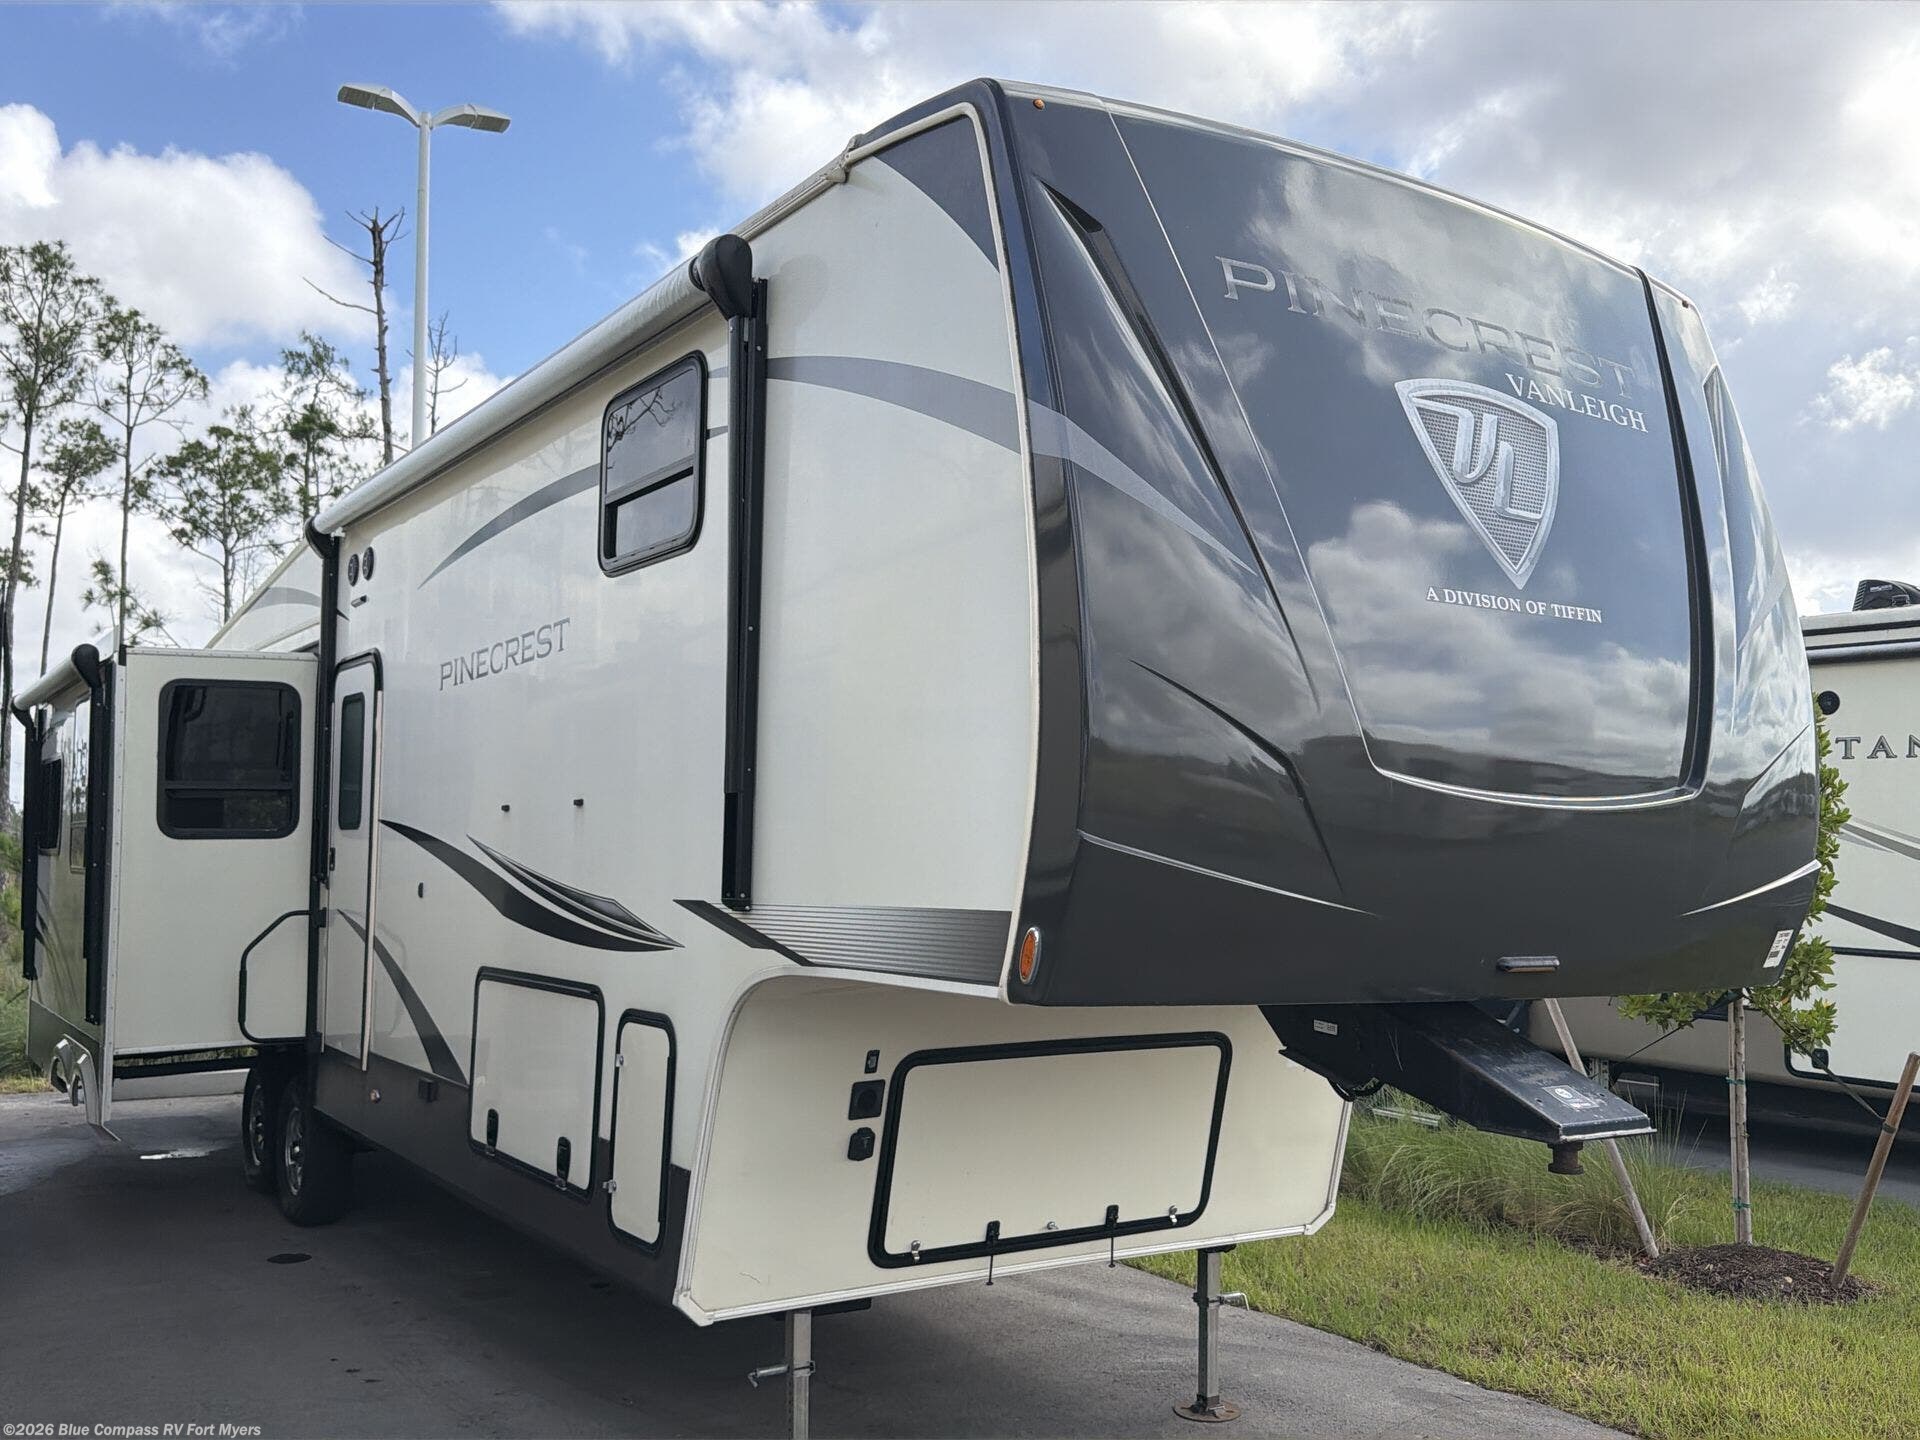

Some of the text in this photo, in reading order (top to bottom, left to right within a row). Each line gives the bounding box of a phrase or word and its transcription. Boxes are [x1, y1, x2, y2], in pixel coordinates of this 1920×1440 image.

[1215, 255, 1635, 400] PINECREST
[1505, 372, 1649, 433] VANLEIGH
[1426, 586, 1603, 623] A DIVISION OF TIFFIN
[439, 617, 571, 691] PINECREST
